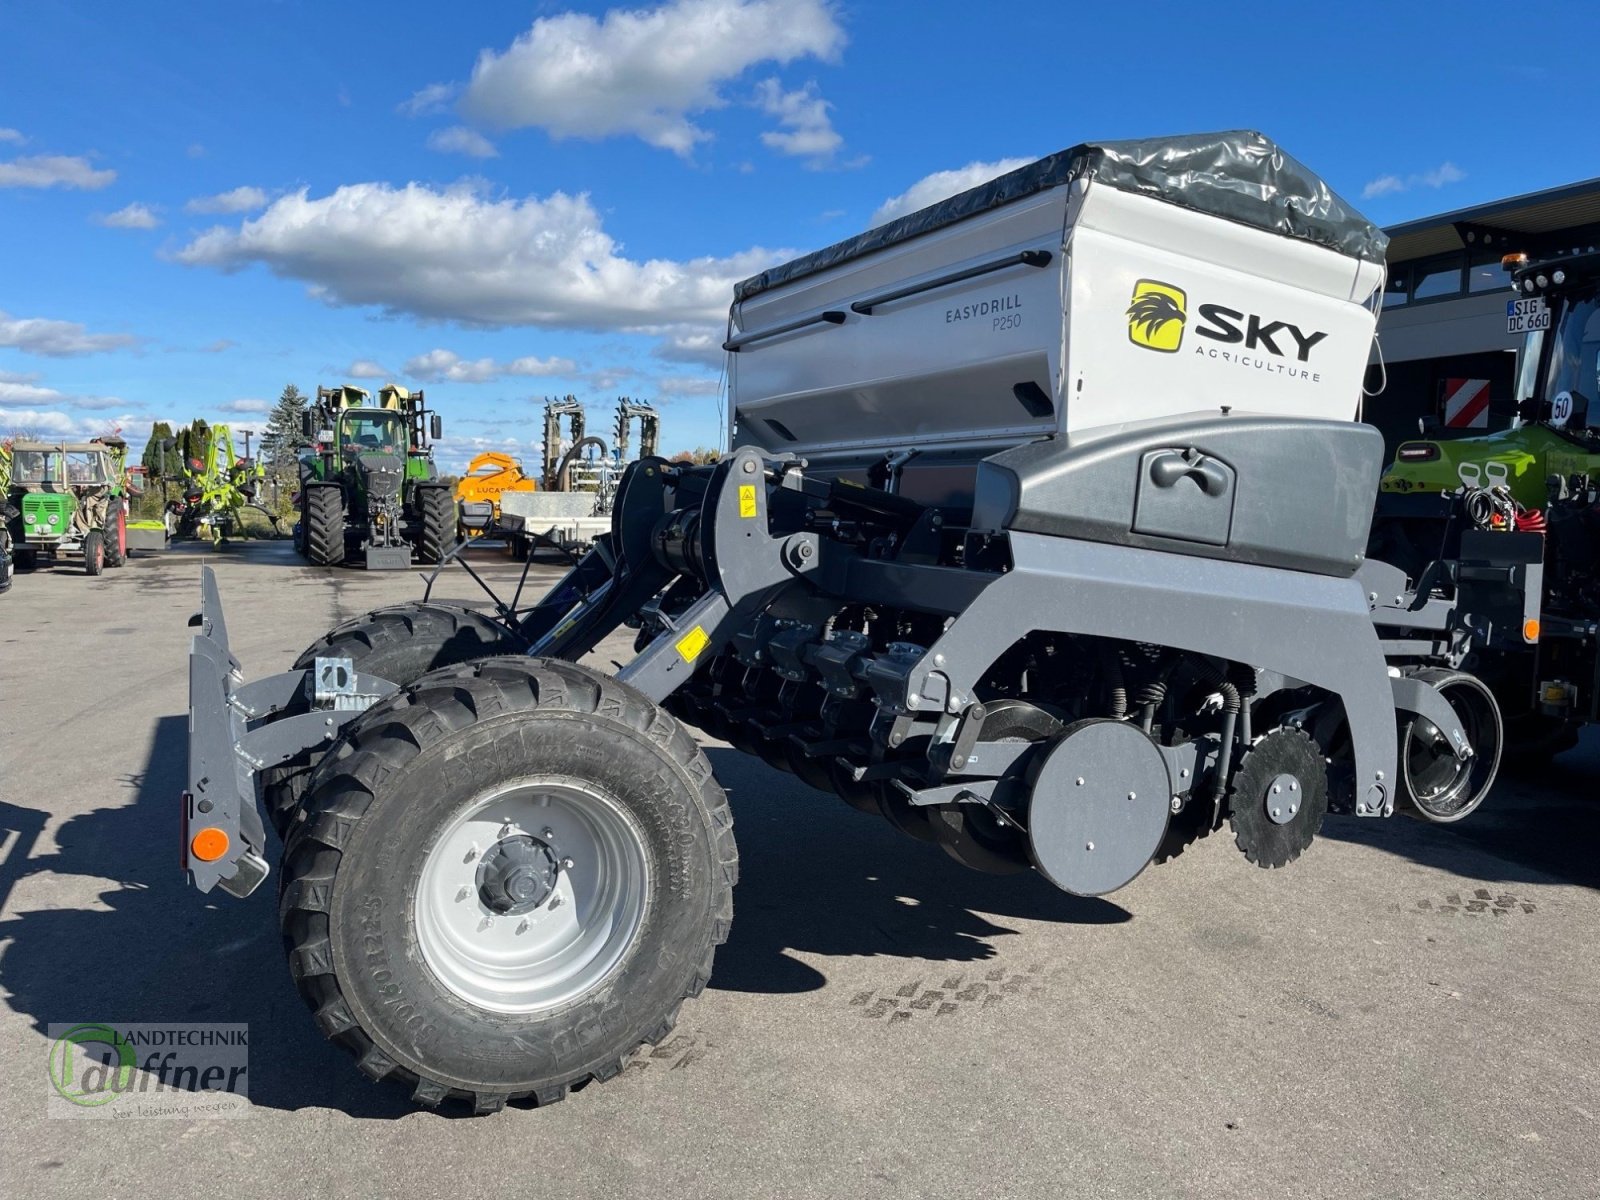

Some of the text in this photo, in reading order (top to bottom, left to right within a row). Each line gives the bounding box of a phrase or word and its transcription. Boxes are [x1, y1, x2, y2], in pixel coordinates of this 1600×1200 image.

[945, 294, 1022, 323] EASYDRILL
[1514, 299, 1537, 316] SIG
[992, 313, 1022, 333] P250
[1194, 303, 1329, 362] SKY
[1509, 313, 1549, 332] DC 660
[1194, 345, 1322, 383] AGRICULTURE
[1554, 397, 1569, 419] 50
